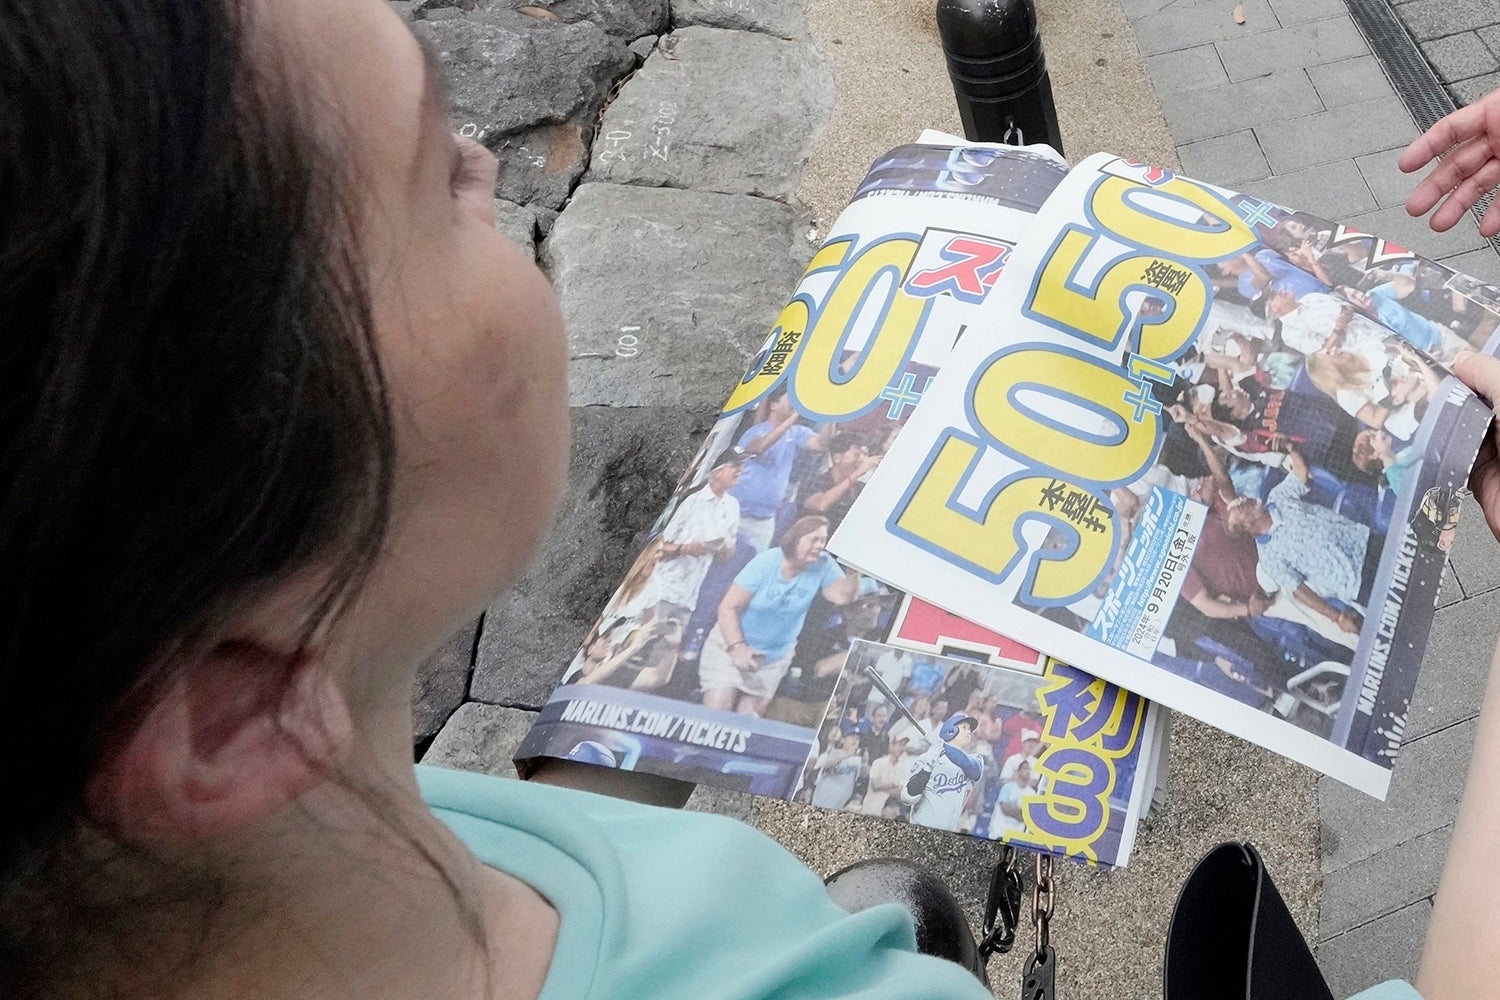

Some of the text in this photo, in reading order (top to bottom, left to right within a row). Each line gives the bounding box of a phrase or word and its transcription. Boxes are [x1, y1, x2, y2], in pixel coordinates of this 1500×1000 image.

[1038, 482, 1113, 535] 本塁打
[1093, 485, 1165, 642] スポーツニッポン
[559, 698, 752, 754] MARLINS.COM/TICKETS
